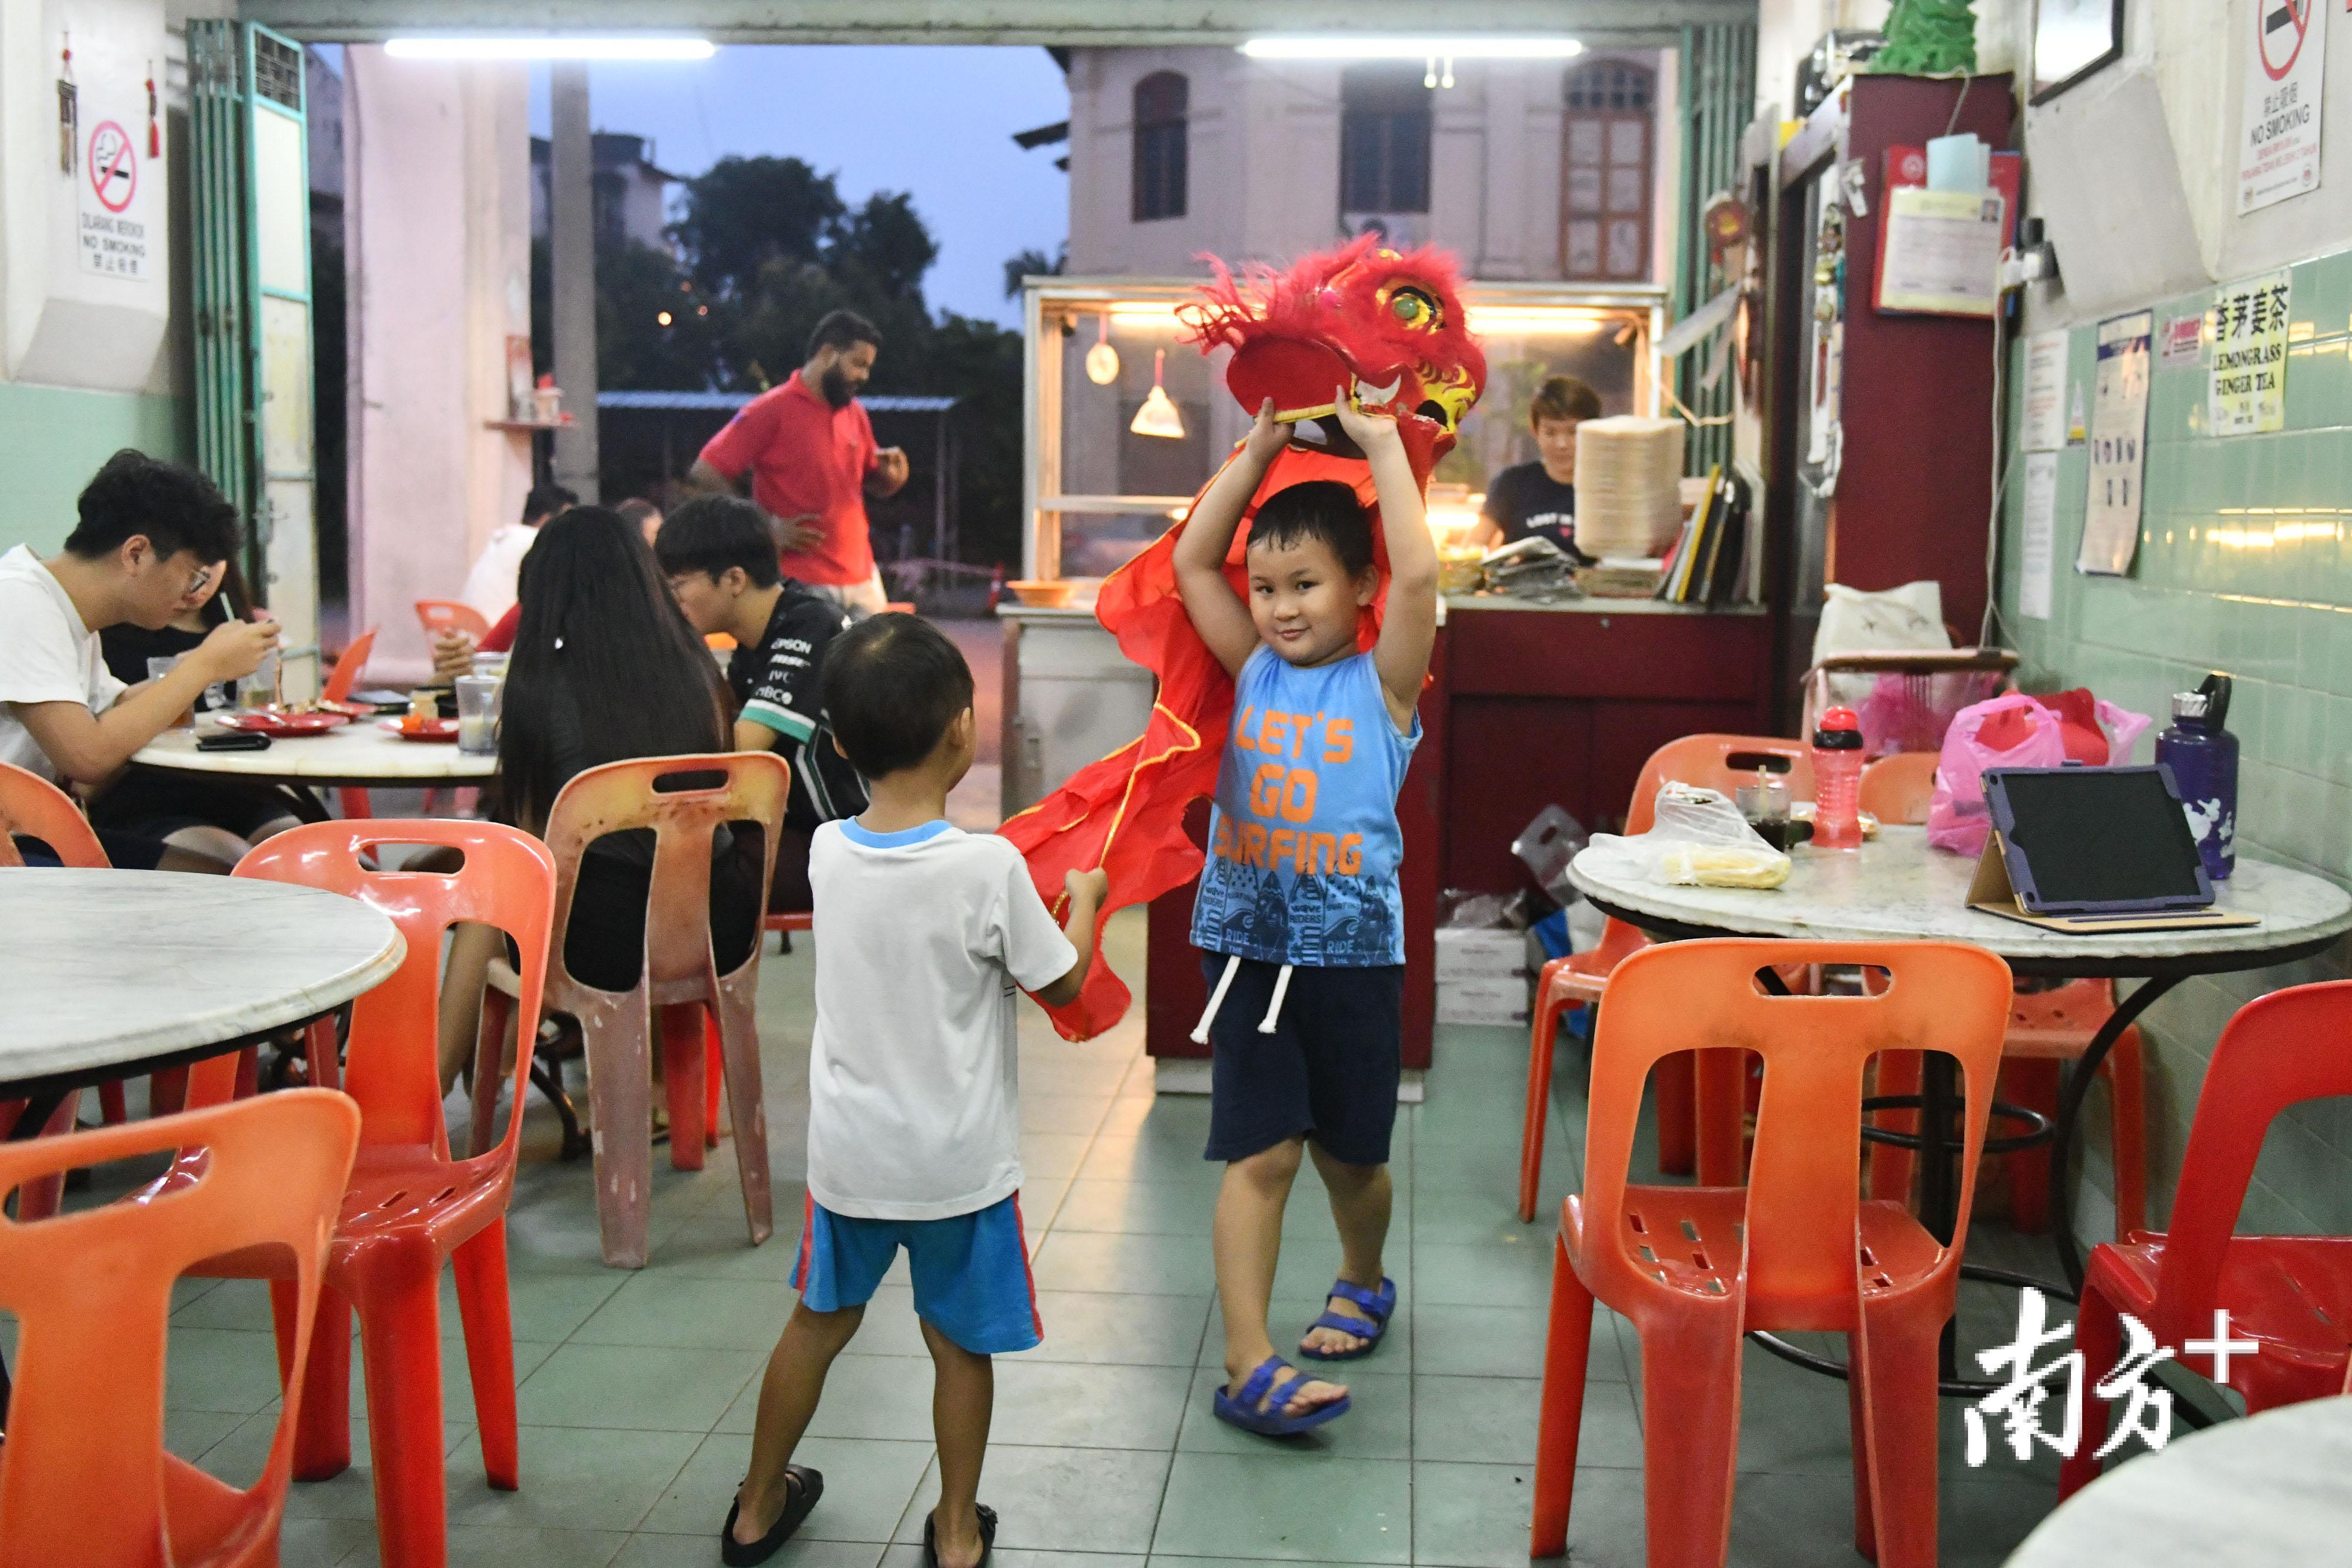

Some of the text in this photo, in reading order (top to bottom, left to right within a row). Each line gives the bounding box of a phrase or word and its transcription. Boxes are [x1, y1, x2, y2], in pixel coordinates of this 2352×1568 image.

[2250, 103, 2310, 147] NO SMOKING
[83, 235, 145, 258] NO SMOKING
[2214, 283, 2288, 342] 香茅姜茶
[2213, 343, 2281, 372] LEMONGRASS
[2216, 372, 2276, 396] GINGER TEA
[1235, 705, 1354, 763] LET'S
[1250, 762, 1318, 823] GO
[1213, 813, 1363, 875] SURFING
[1327, 940, 1355, 954] RIDE
